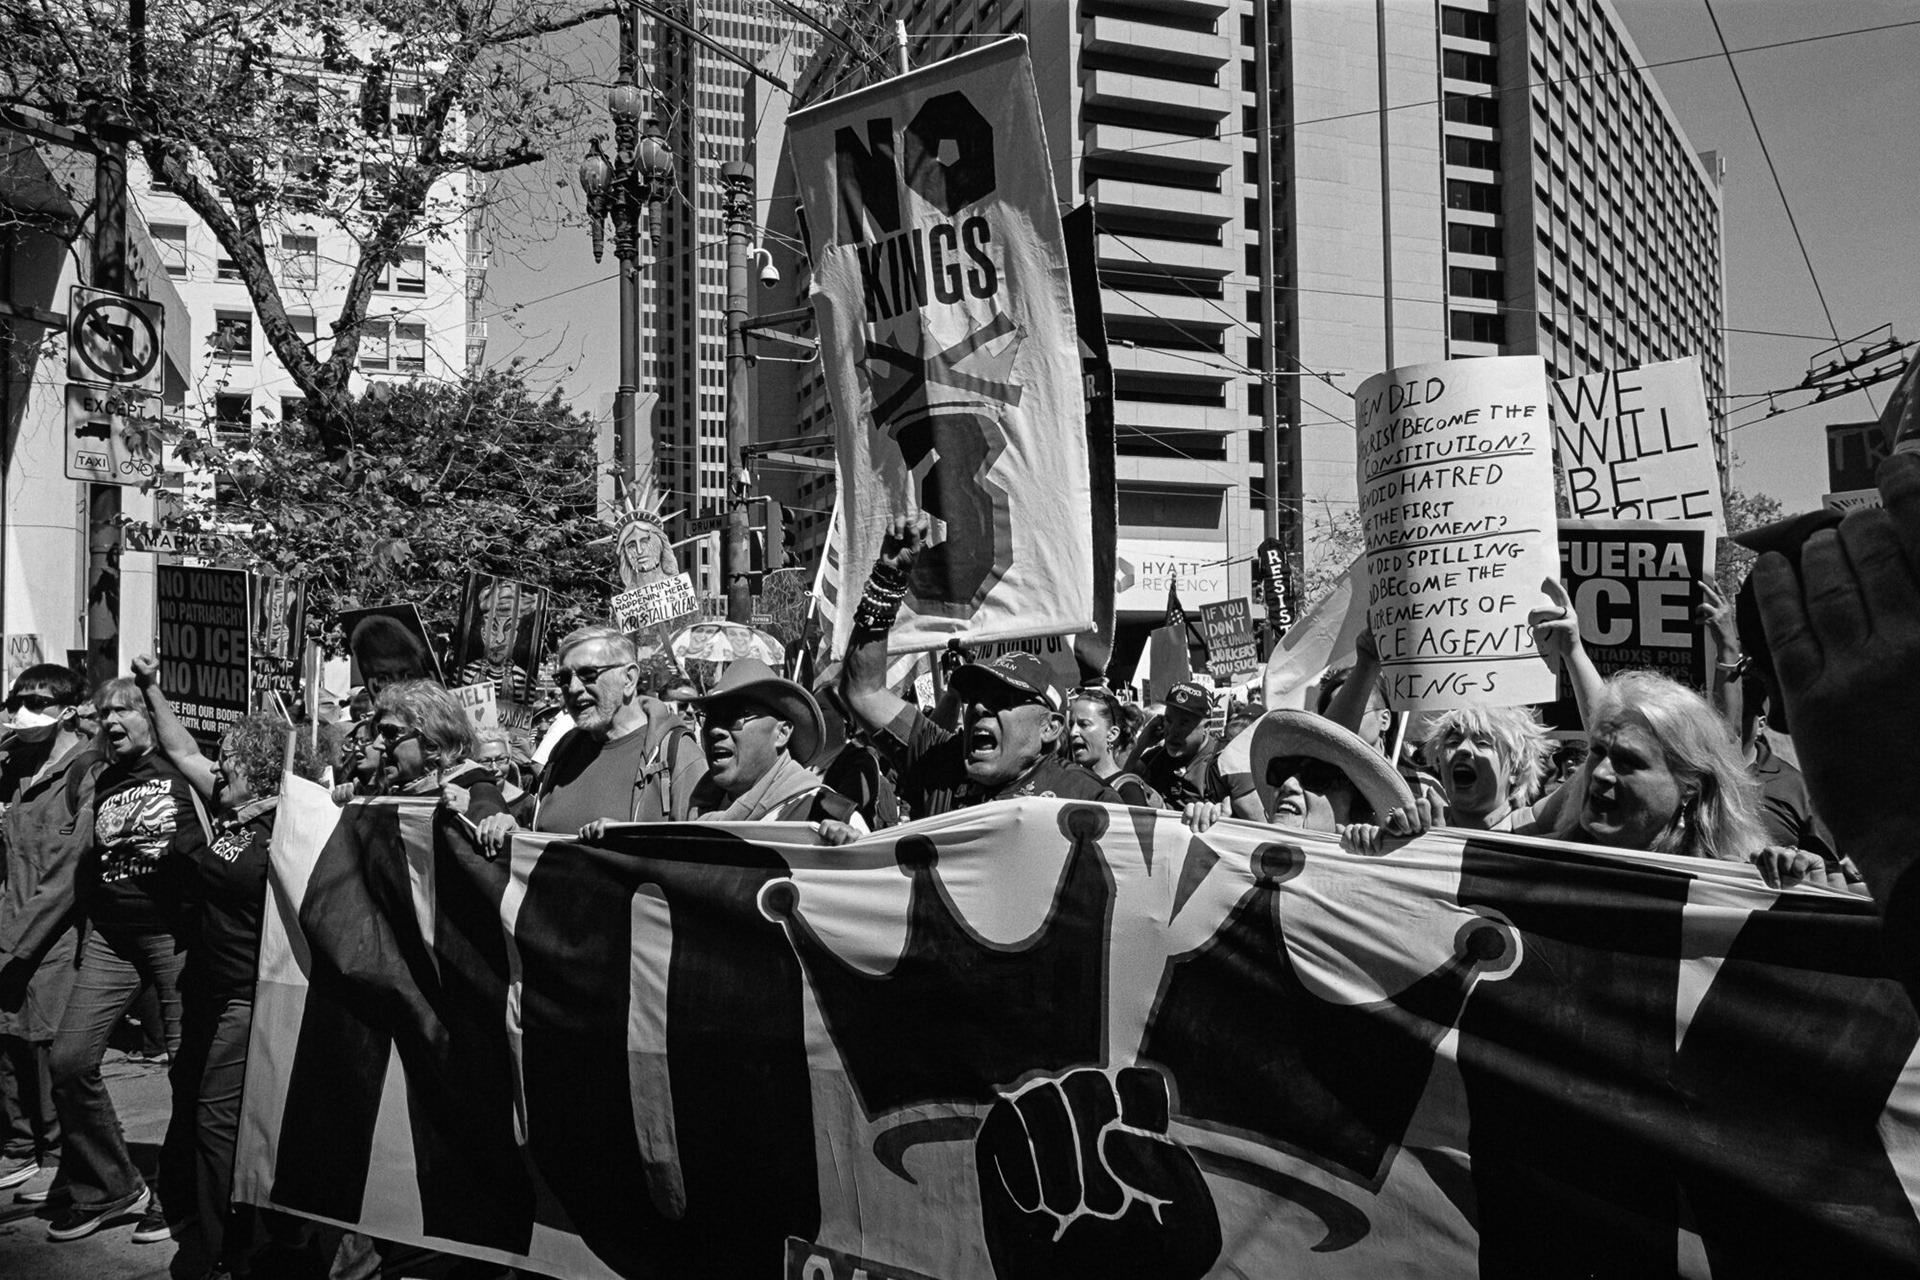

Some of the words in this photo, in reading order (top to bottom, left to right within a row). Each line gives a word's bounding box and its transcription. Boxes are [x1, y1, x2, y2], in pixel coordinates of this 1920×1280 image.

[835, 90, 996, 246] NO
[857, 216, 998, 323] KINGS
[84, 398, 146, 418] EXCEPT
[1389, 377, 1445, 414] DID
[1551, 366, 1645, 424] WE
[1402, 409, 1481, 439] BECOME
[1490, 404, 1537, 420] THE
[1557, 407, 1698, 467] WILL
[78, 456, 107, 467] TAXI
[1365, 432, 1531, 479] CONSTITUTION?
[1401, 463, 1503, 495] HATRED
[1568, 457, 1644, 514] BE
[692, 519, 722, 532] DRUMM
[1373, 507, 1399, 530] THE
[1403, 501, 1454, 520] FIRST
[1366, 516, 1507, 549] AMENDMENT?
[1142, 562, 1199, 575] HYATT
[1377, 556, 1402, 575] DID
[1407, 543, 1524, 568] SPILLING
[160, 570, 185, 598] NO
[189, 572, 245, 604] KINGS
[1267, 549, 1292, 634] RESIST
[1381, 573, 1461, 599] BECOME
[1468, 563, 1507, 582] THE
[161, 600, 176, 620] NO
[180, 603, 245, 627] PATRIARCHY
[621, 602, 649, 617] WHAT
[1205, 607, 1217, 621] IF
[1219, 602, 1244, 618] YOU
[1374, 597, 1469, 629] IREMENTS
[1479, 595, 1516, 613] OF
[1560, 577, 1693, 648] CE
[1209, 616, 1245, 637] DON'T
[11, 637, 37, 655] NOT
[161, 622, 198, 659] NO
[204, 627, 246, 666] ICE
[1208, 636, 1227, 650] LIKE
[1210, 644, 1256, 663] WORKERS
[1374, 627, 1406, 660] CE
[1658, 650, 1692, 664] POR
[162, 660, 192, 695] NO
[196, 664, 245, 703] WAR
[1213, 662, 1233, 676] YOU
[1394, 671, 1498, 700] KINGS
[181, 702, 197, 716] FOR
[198, 704, 214, 719] OUR
[202, 719, 216, 732] OUR
